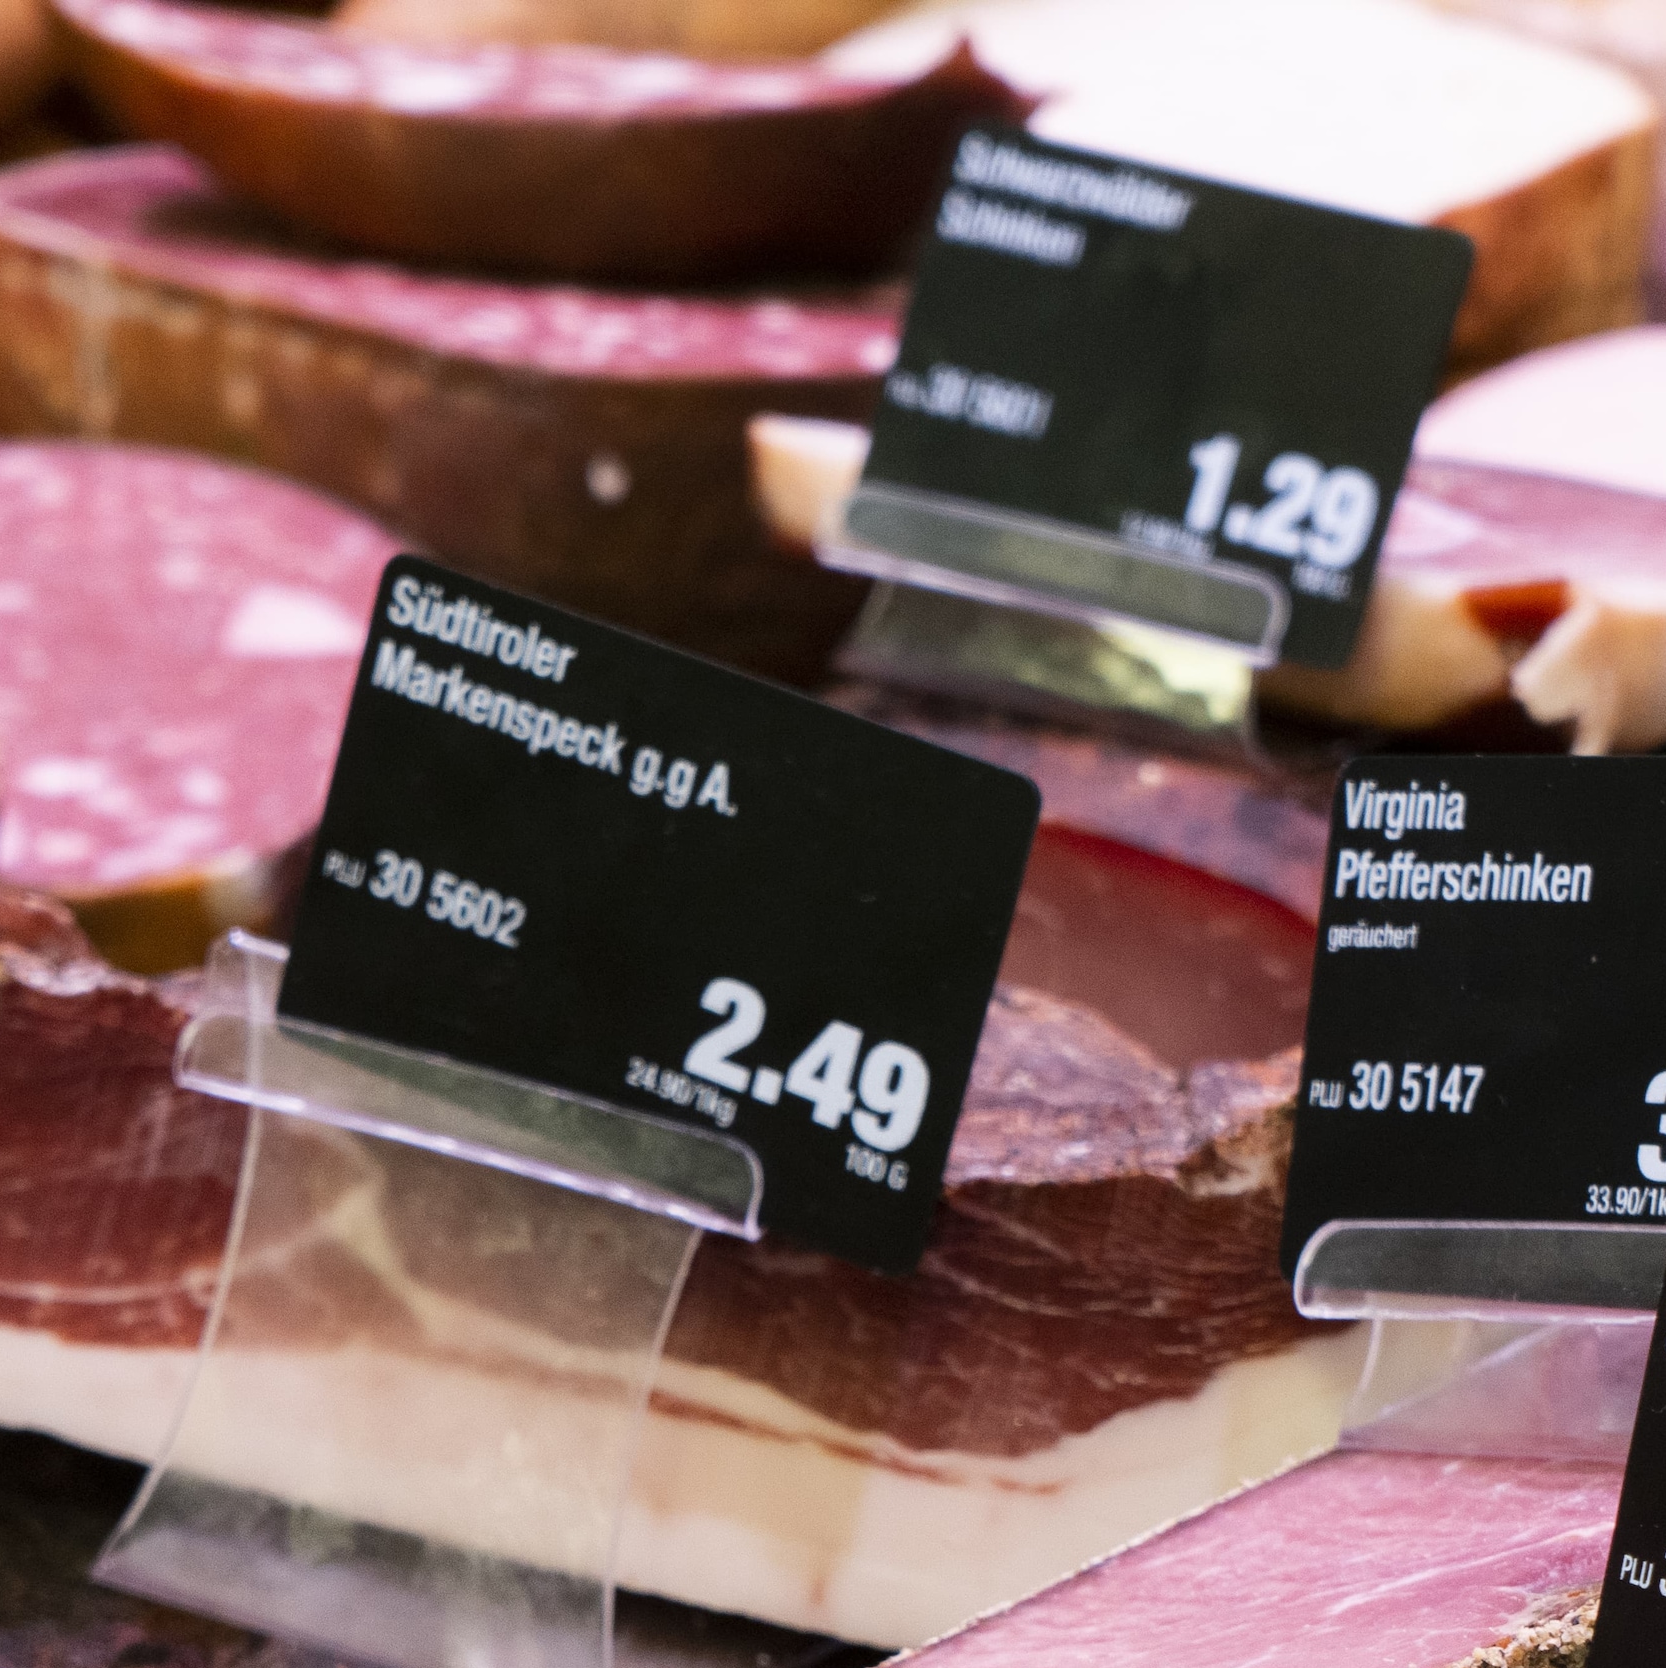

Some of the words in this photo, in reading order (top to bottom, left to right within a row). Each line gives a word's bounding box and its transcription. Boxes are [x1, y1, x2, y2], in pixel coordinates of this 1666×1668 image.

[1184, 432, 1379, 571] 1.29
[386, 574, 578, 683] Südtiroler
[371, 640, 629, 776] Markenspeck
[1344, 779, 1467, 841] Virginia
[323, 851, 368, 889] PLU
[368, 851, 420, 908] 30
[427, 872, 527, 948] 5602
[1334, 848, 1593, 903] Pfefferschinken
[1327, 920, 1420, 952] geräuchert
[625, 1055, 738, 1128] 24.90/1kg
[684, 977, 930, 1152] 2.49
[1309, 1079, 1345, 1108] PLU
[1349, 1061, 1393, 1111] 30
[1399, 1063, 1485, 1114] 5147
[845, 1143, 886, 1182] 100
[887, 1160, 909, 1191] G
[1620, 1553, 1654, 1592] PLU
